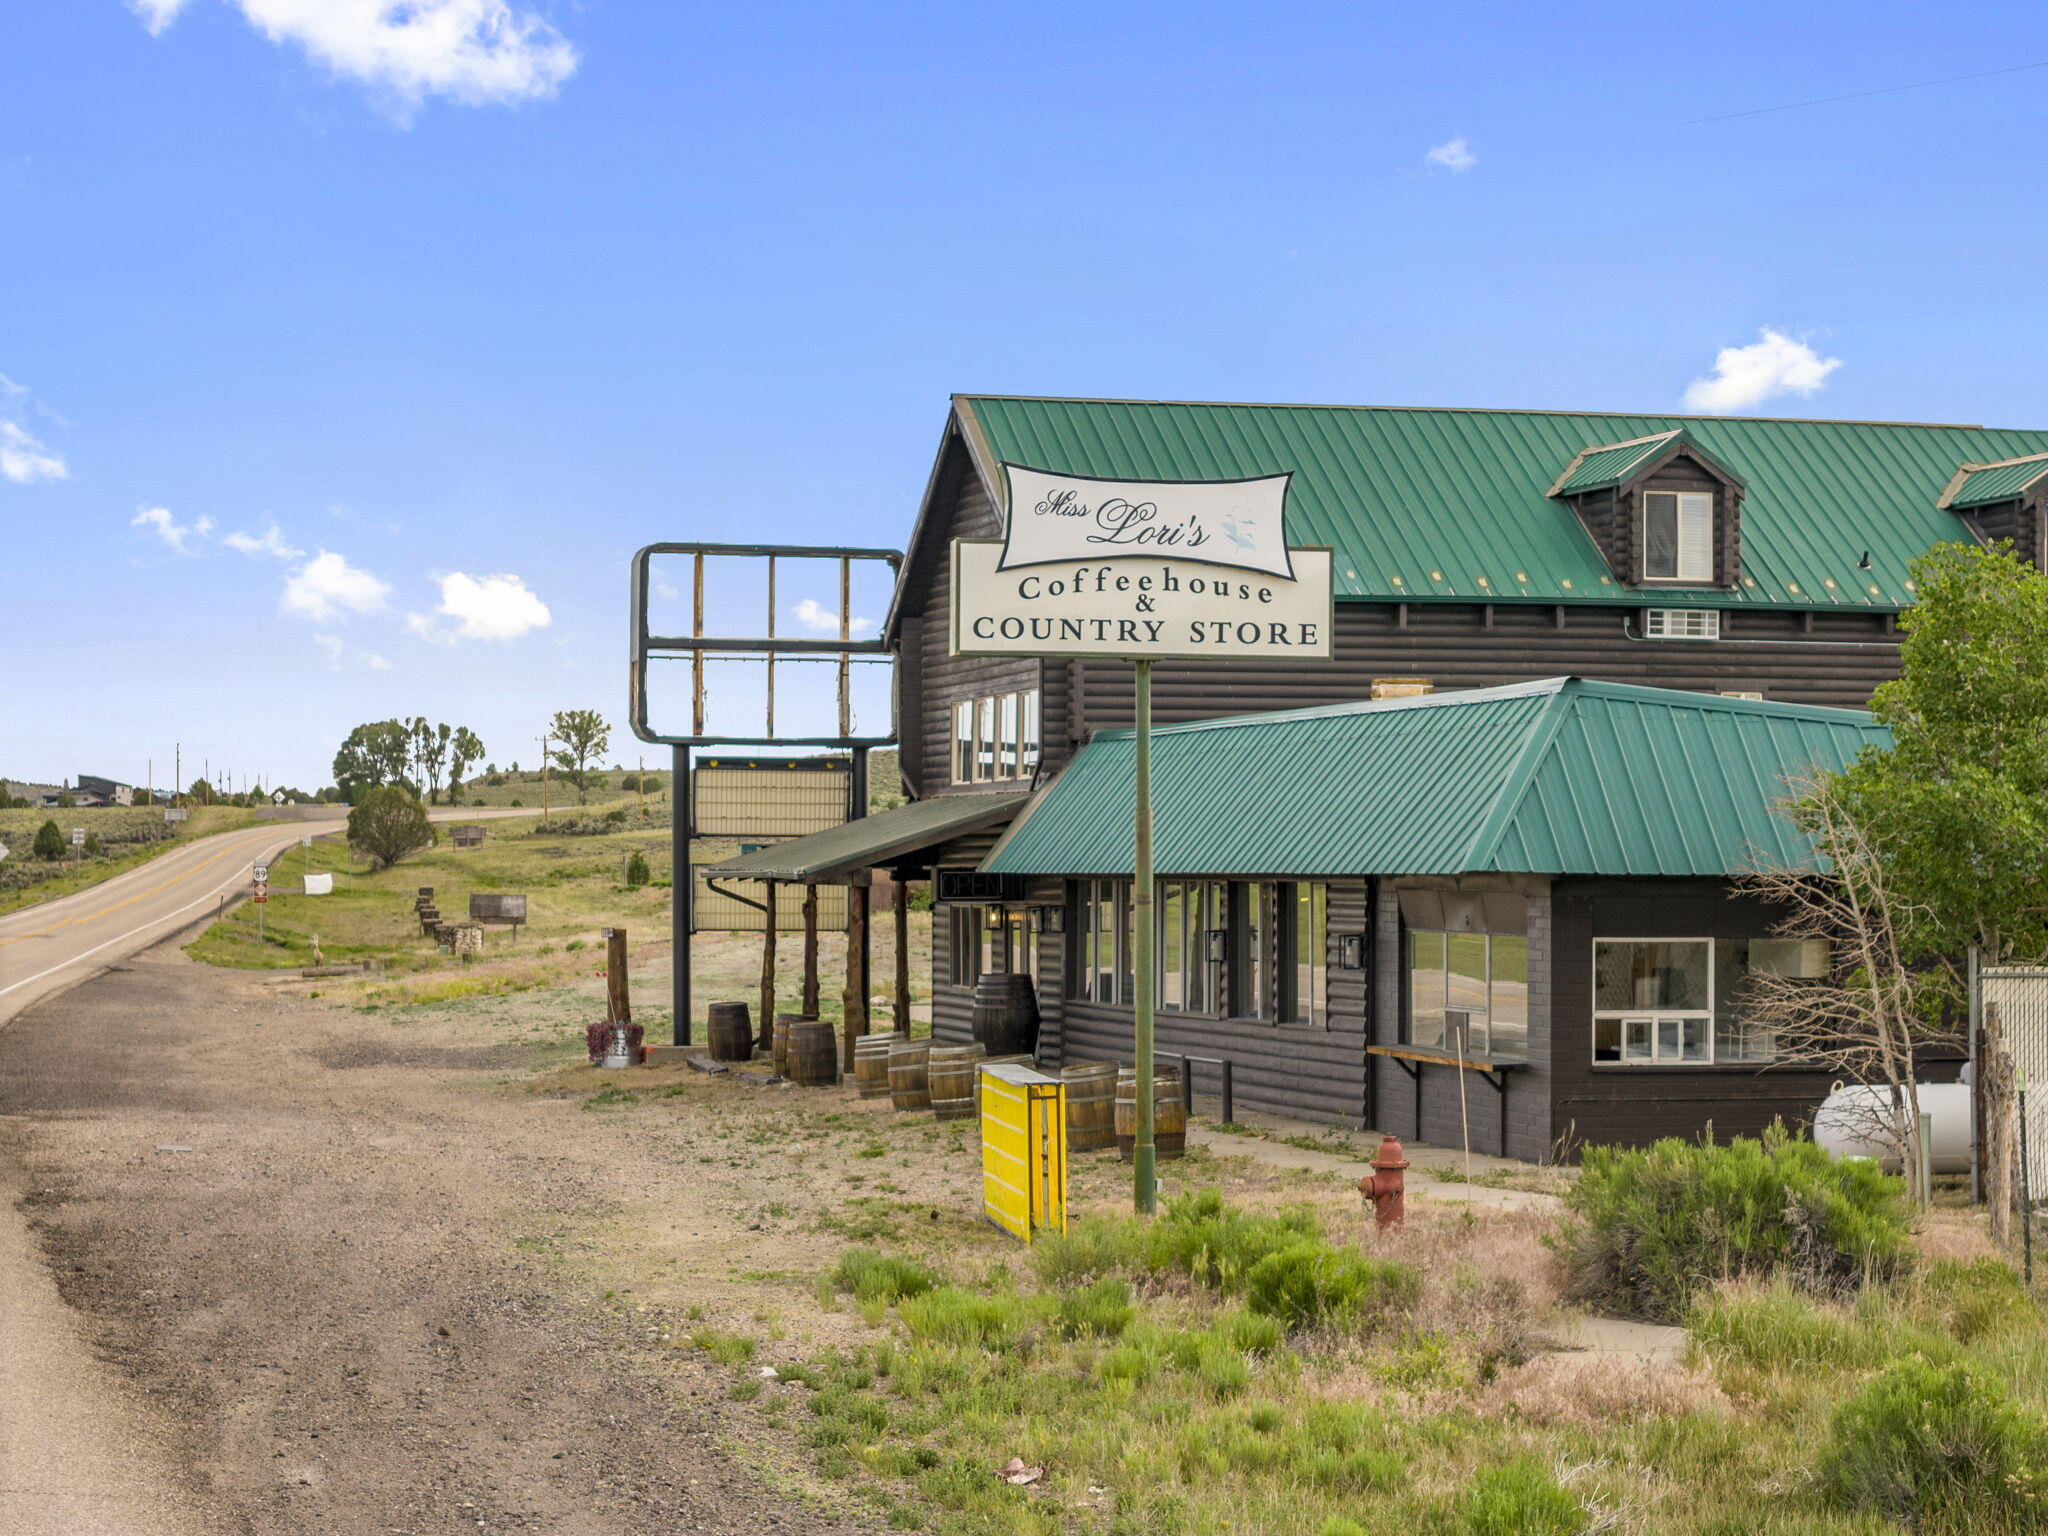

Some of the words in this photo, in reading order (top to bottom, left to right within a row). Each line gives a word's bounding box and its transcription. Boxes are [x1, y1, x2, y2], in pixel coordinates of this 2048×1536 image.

[1034, 489, 1091, 517] Miss
[1086, 498, 1210, 546] Lori's
[1018, 566, 1273, 604] Coffeehouse
[1135, 593, 1156, 613] &
[972, 616, 1166, 643] COUNTRY
[1189, 620, 1318, 646] STORE
[255, 870, 266, 879] 89
[942, 873, 1000, 896] OPEN
